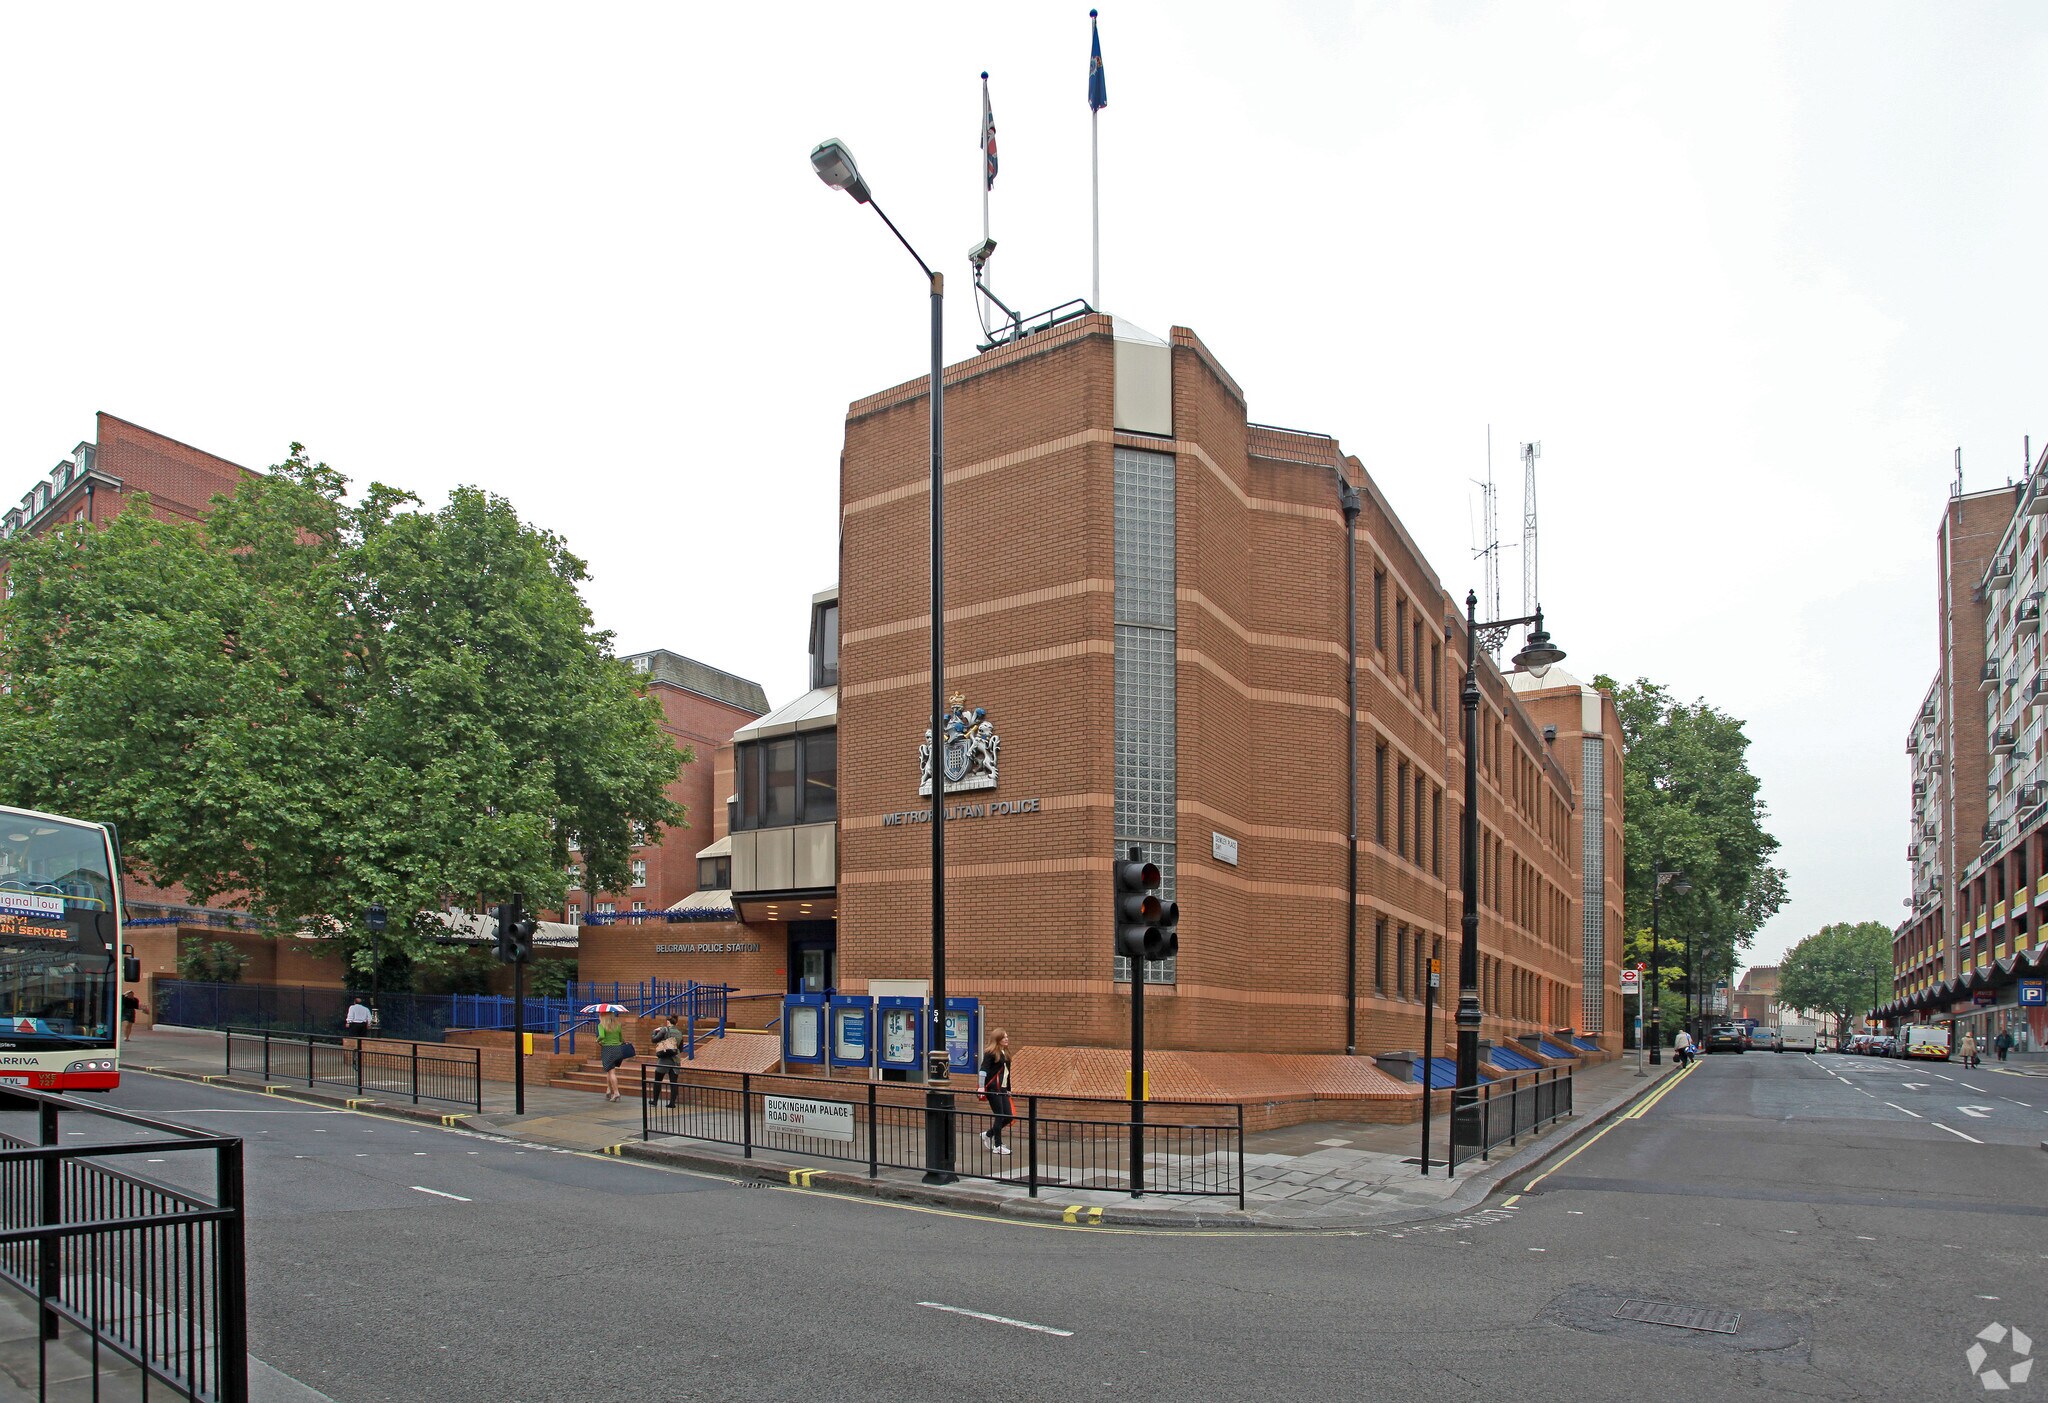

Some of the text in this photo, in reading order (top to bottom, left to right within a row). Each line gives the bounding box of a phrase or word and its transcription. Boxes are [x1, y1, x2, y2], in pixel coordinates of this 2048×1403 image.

[990, 799, 1040, 815] POLICE
[36, 897, 59, 909] Tour
[0, 924, 68, 939] IN SERVICE
[656, 943, 759, 953] BELGRAVIA POLICE STATION
[2027, 990, 2038, 1000] P
[768, 1100, 848, 1117] BUCKINGHAM PALACE
[768, 1110, 805, 1124] ROAD SW1
